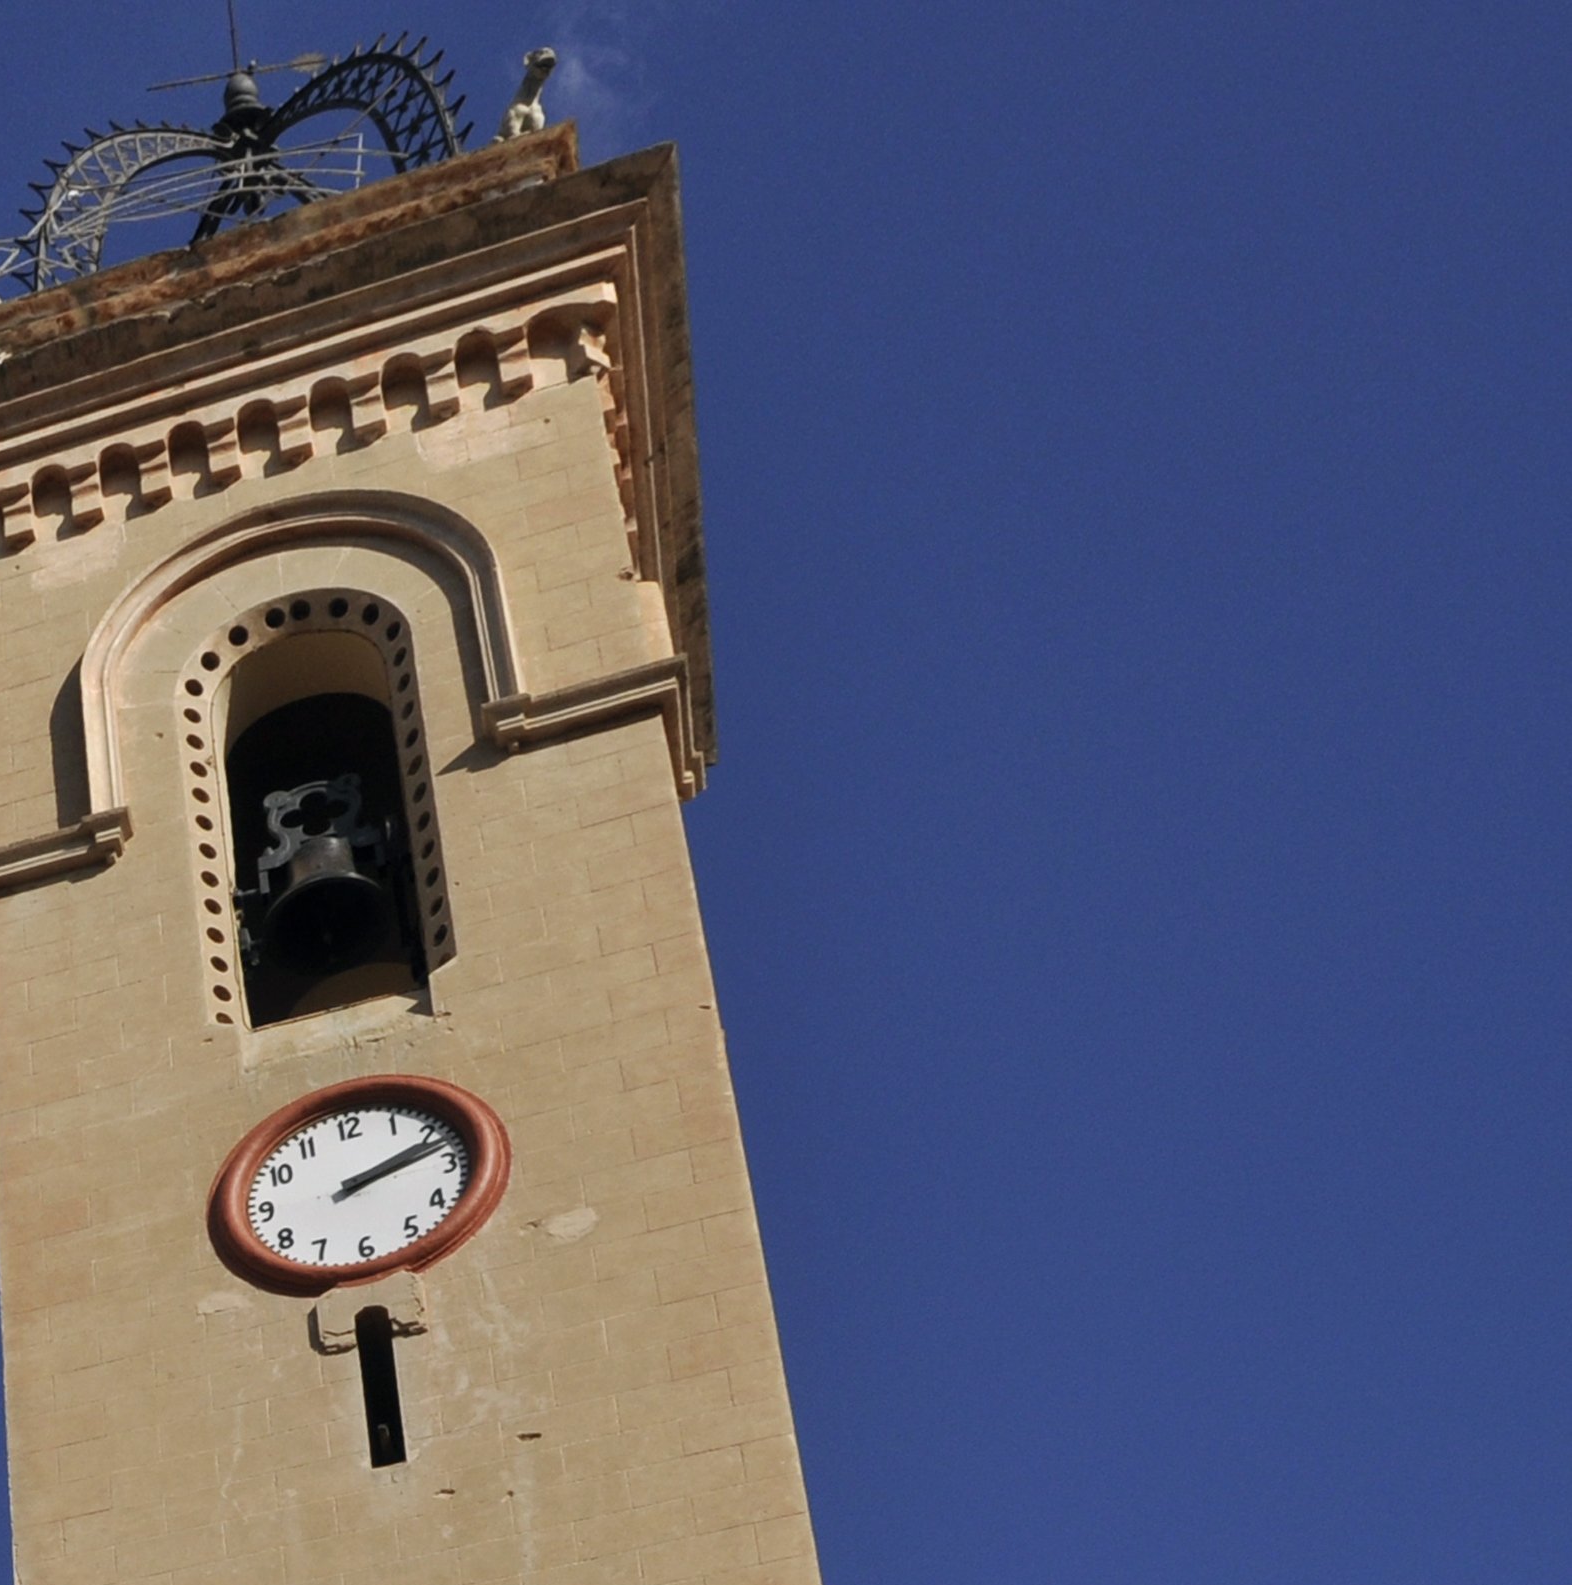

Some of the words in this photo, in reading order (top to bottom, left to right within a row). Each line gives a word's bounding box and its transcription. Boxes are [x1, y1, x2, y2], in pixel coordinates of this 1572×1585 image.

[337, 1116, 363, 1141] 12
[388, 1114, 397, 1136] 1
[299, 1136, 316, 1159] 11
[440, 1152, 457, 1174] 3
[270, 1163, 293, 1187] 10
[429, 1188, 446, 1209] 4
[258, 1201, 275, 1223] 9
[403, 1215, 419, 1238] 5
[277, 1228, 294, 1250] 8
[311, 1238, 327, 1261] 7
[358, 1236, 375, 1258] 6
